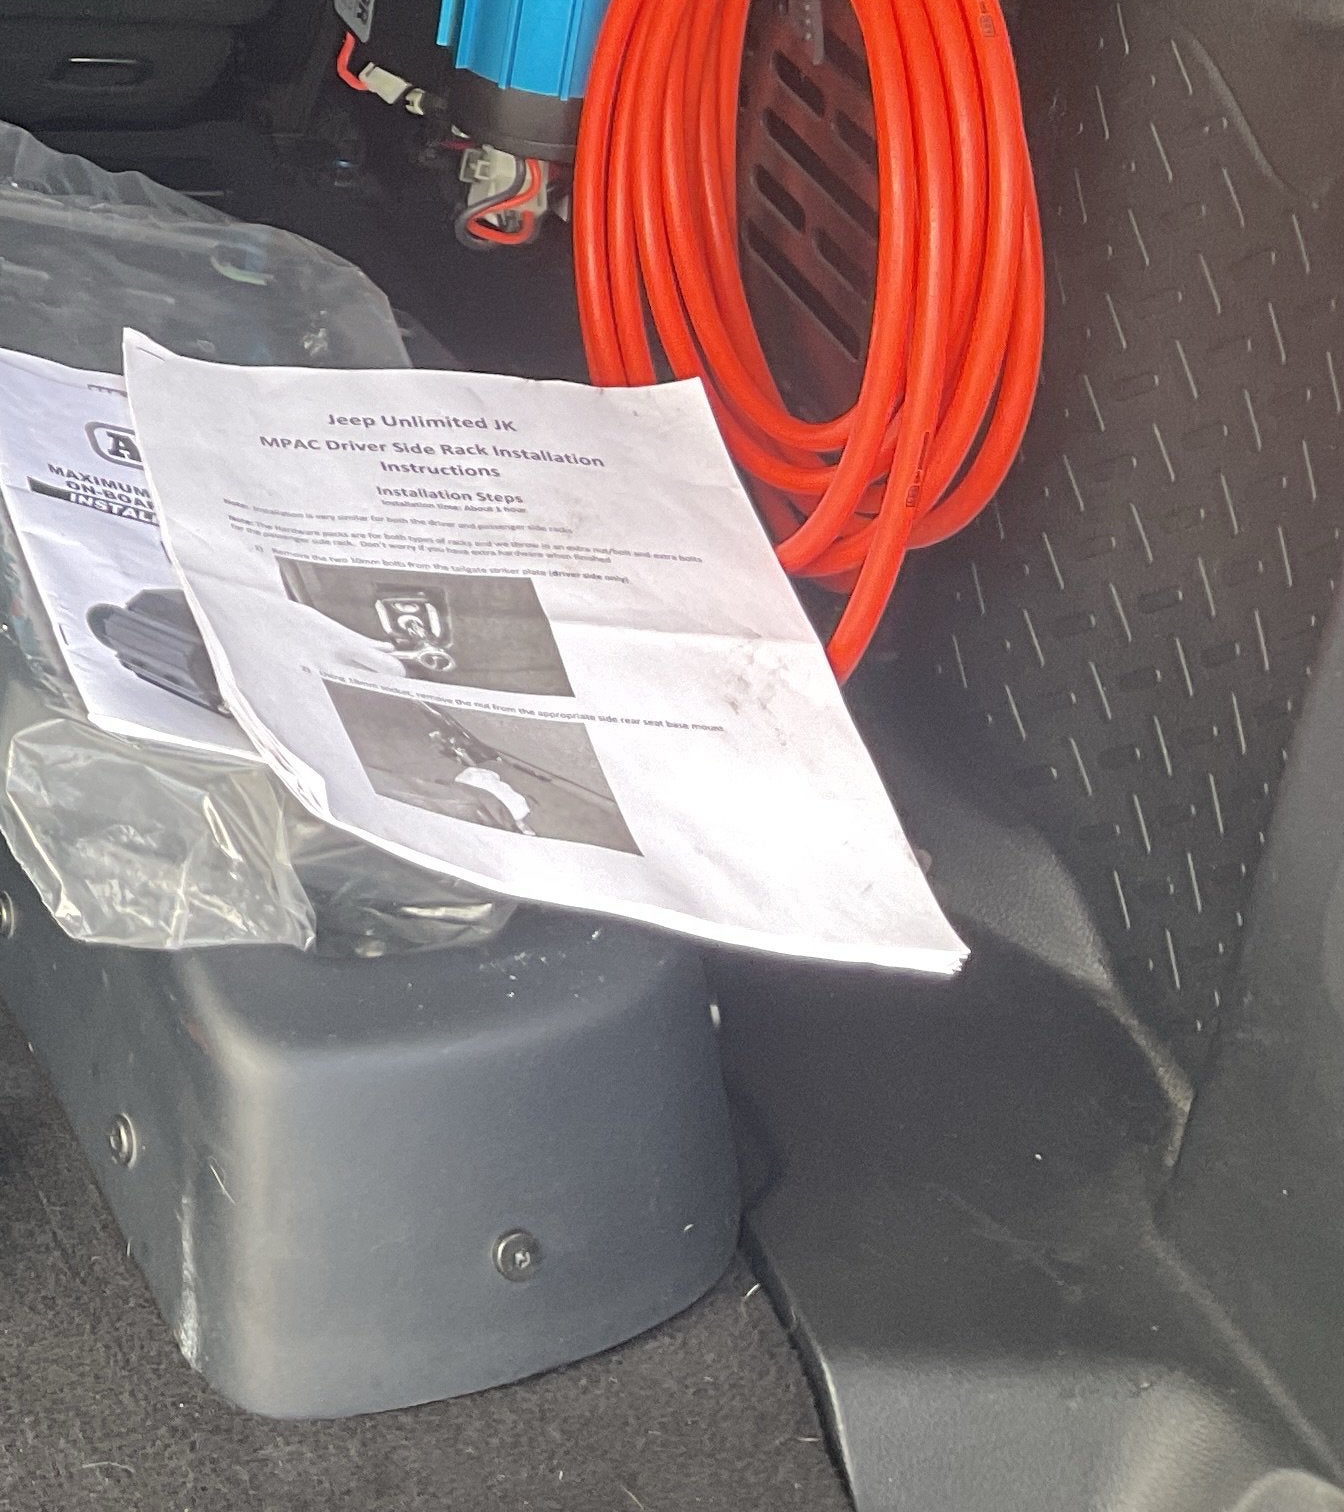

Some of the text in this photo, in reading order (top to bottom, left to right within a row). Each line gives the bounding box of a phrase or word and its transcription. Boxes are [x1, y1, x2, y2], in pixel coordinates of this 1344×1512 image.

[328, 414, 517, 431] Jeep Unlimited JK
[260, 436, 605, 467] MPAC Driver Side Rack Installation
[380, 461, 501, 478] Instructions
[47, 463, 150, 499] MAXIMUM
[376, 486, 524, 504] Installation Steps
[381, 500, 435, 509] Installation
[642, 719, 664, 727] seat
